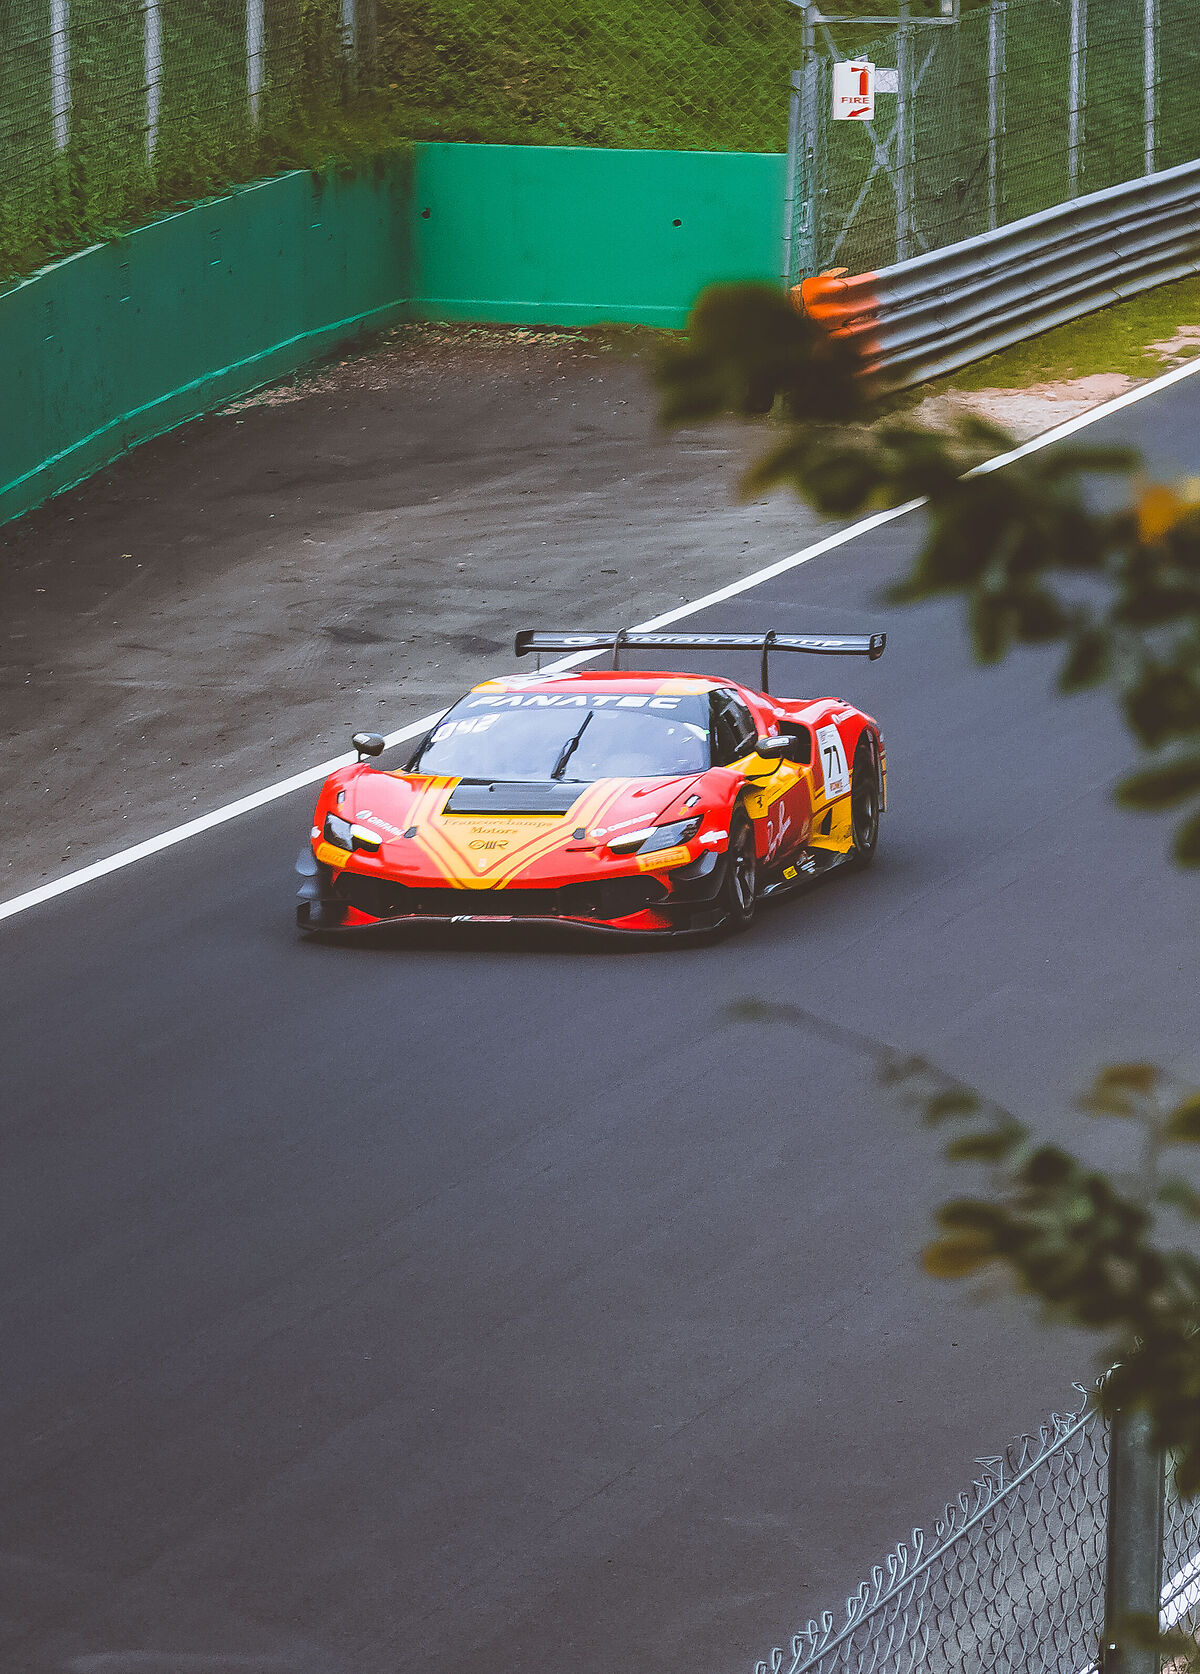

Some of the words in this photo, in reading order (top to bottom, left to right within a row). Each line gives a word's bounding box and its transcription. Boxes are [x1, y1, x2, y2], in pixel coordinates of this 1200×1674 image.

[841, 96, 870, 104] FIRE
[467, 695, 683, 709] FANATEC
[823, 745, 842, 778] 71
[471, 826, 519, 834] Motors
